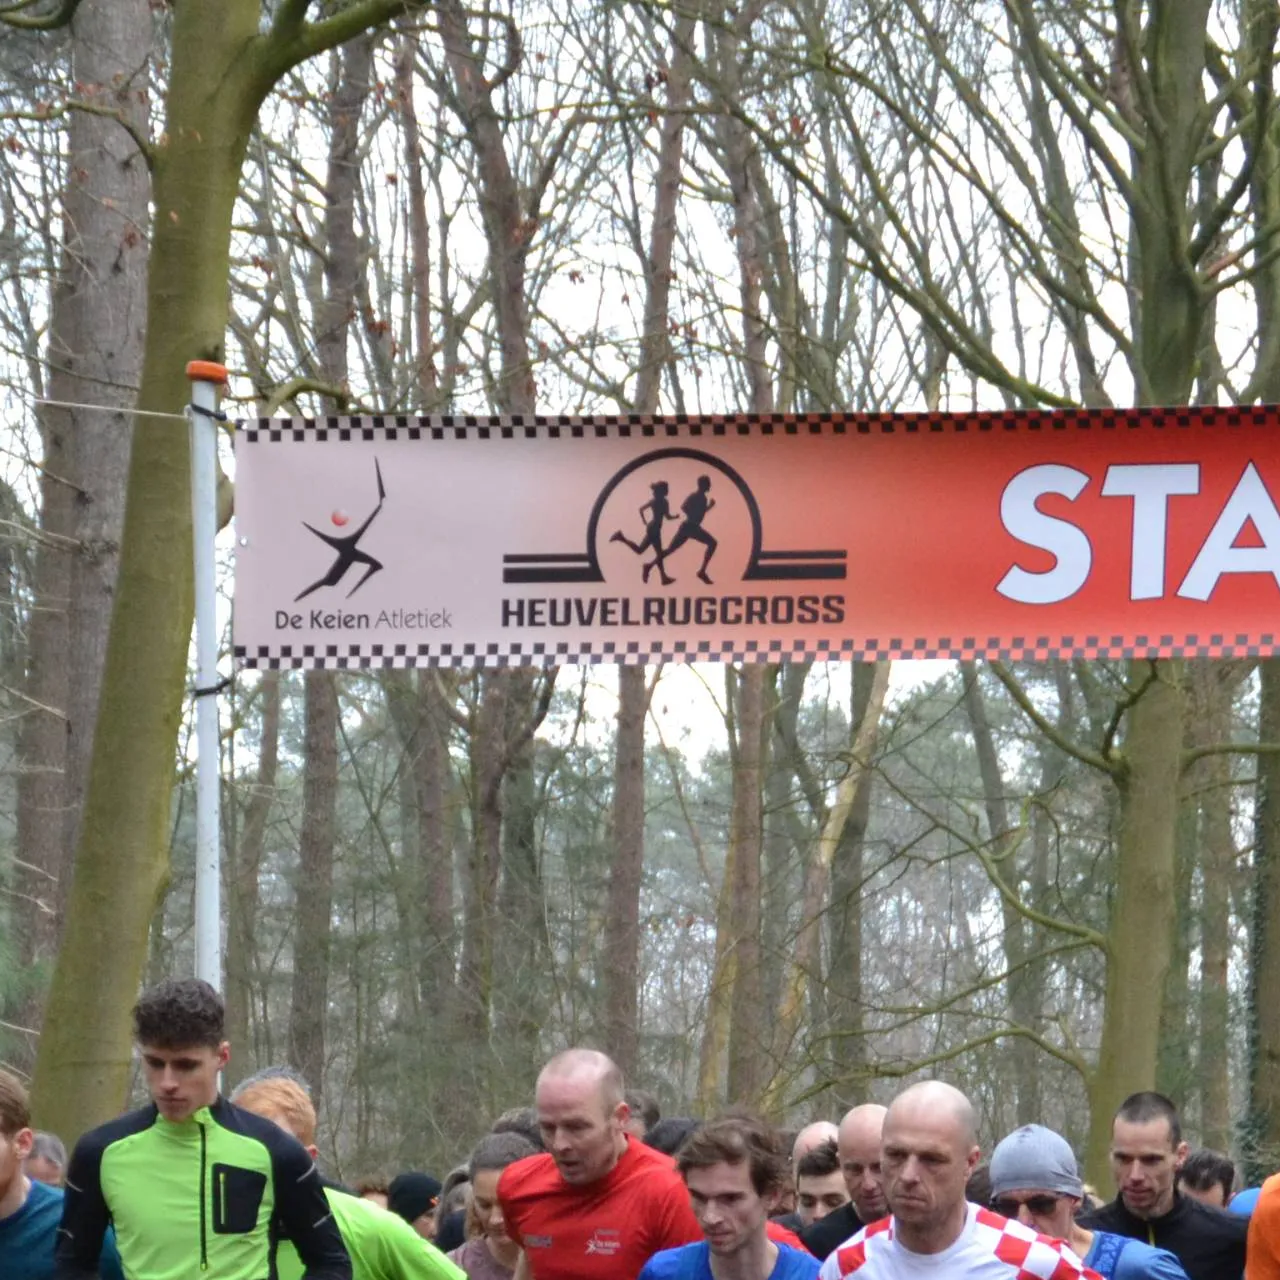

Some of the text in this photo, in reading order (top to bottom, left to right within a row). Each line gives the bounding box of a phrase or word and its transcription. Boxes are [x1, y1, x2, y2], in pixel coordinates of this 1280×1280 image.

[275, 607, 453, 630] De Keien Atletiek
[501, 594, 846, 628] HEUVELRUGCROSS
